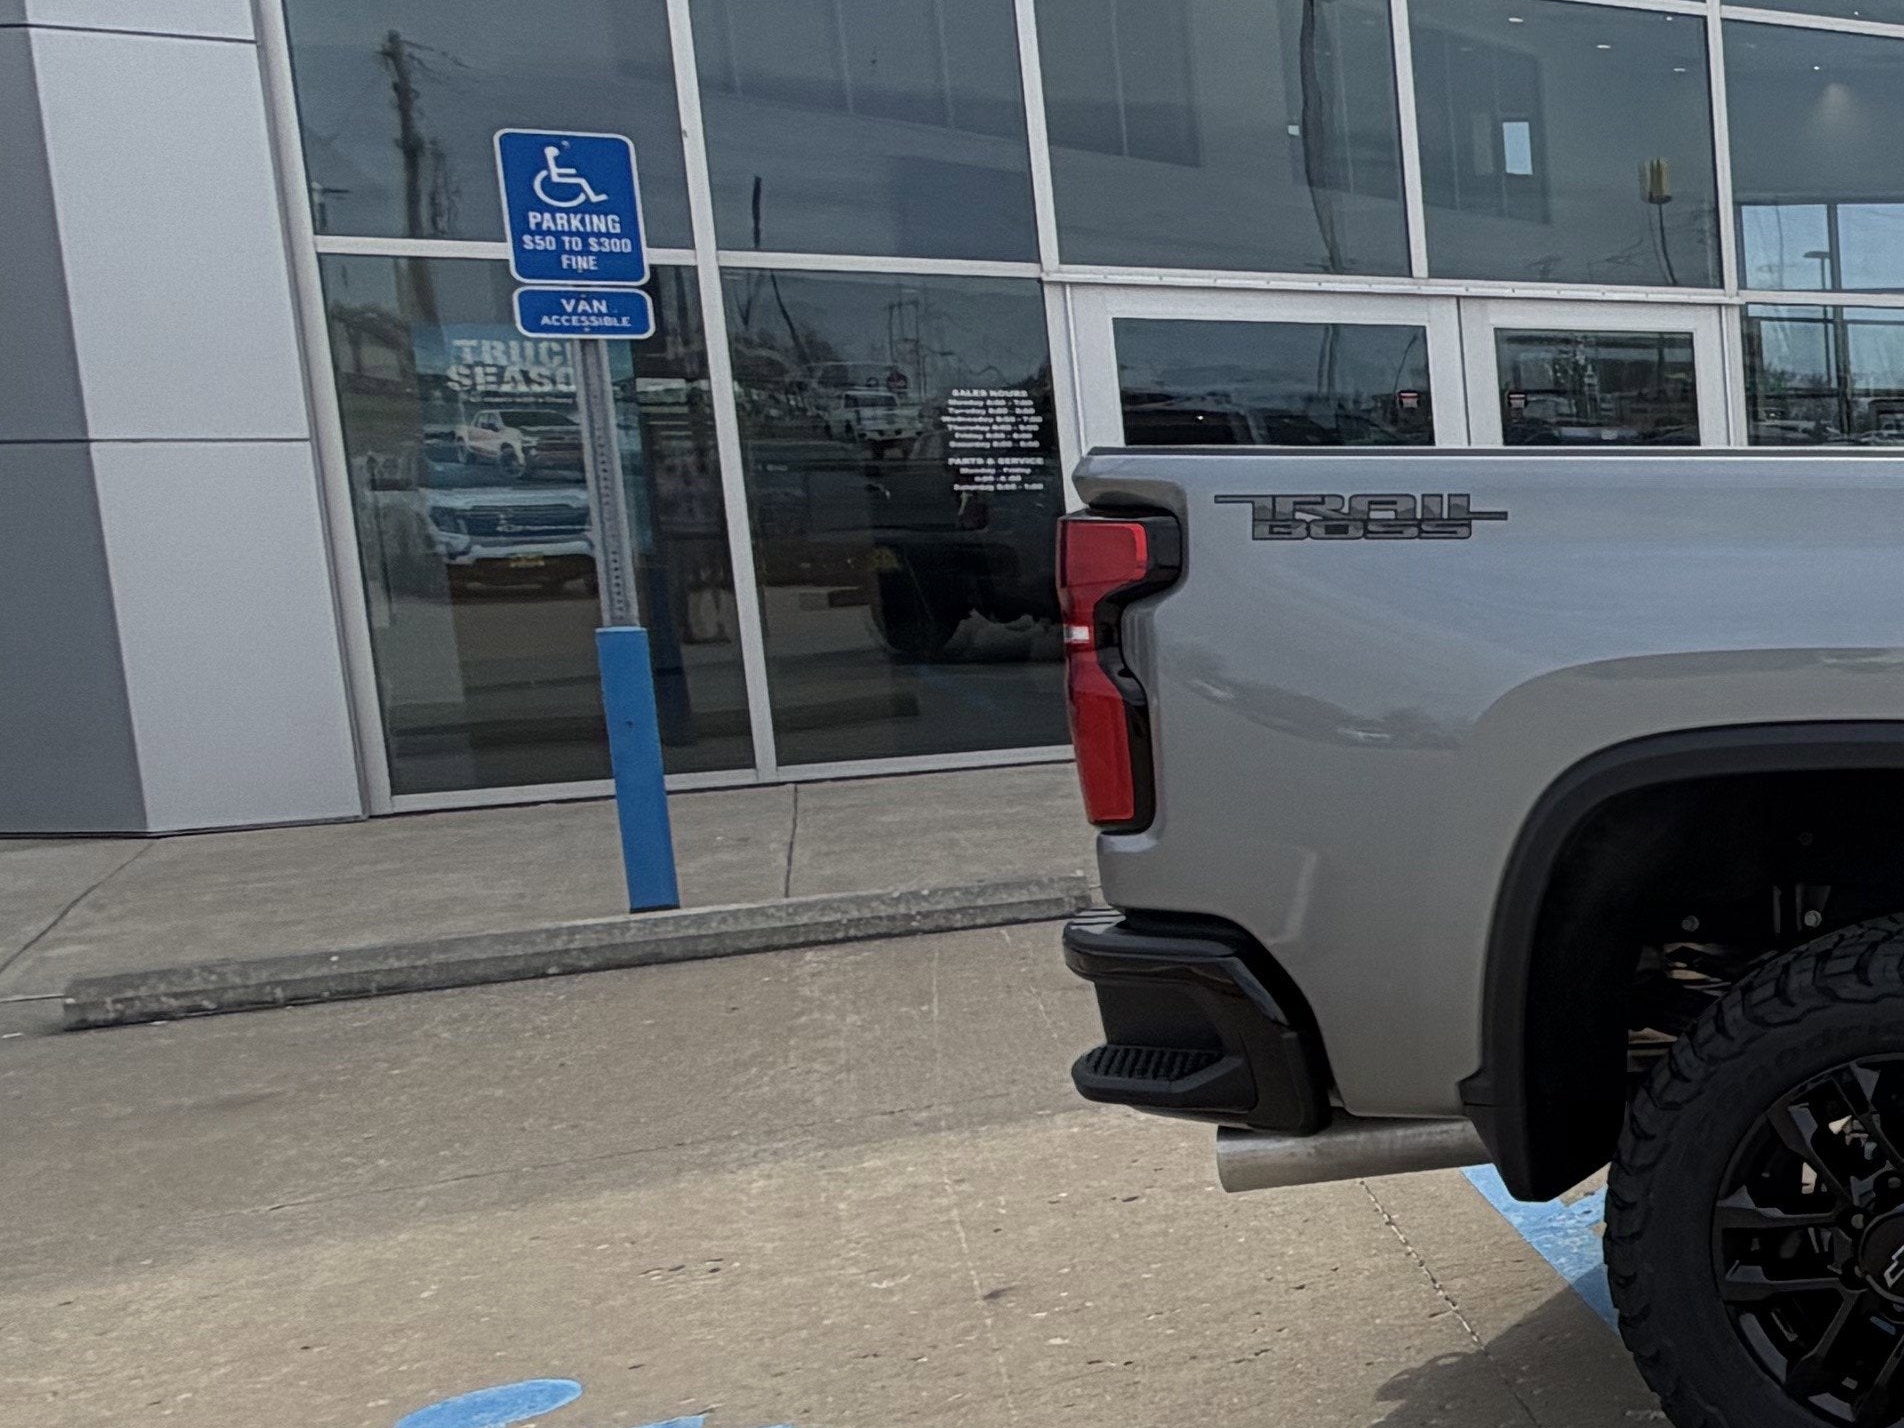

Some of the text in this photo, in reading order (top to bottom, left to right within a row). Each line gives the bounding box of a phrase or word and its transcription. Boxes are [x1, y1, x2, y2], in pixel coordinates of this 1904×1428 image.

[527, 211, 622, 234] PARKING
[521, 234, 633, 254] $50 TO $300
[560, 254, 599, 271] FINE
[560, 298, 609, 314] VAN
[540, 315, 632, 328] ACCESSIBLE
[1213, 493, 1509, 522] TRAIL
[1251, 518, 1473, 541] BOSS
